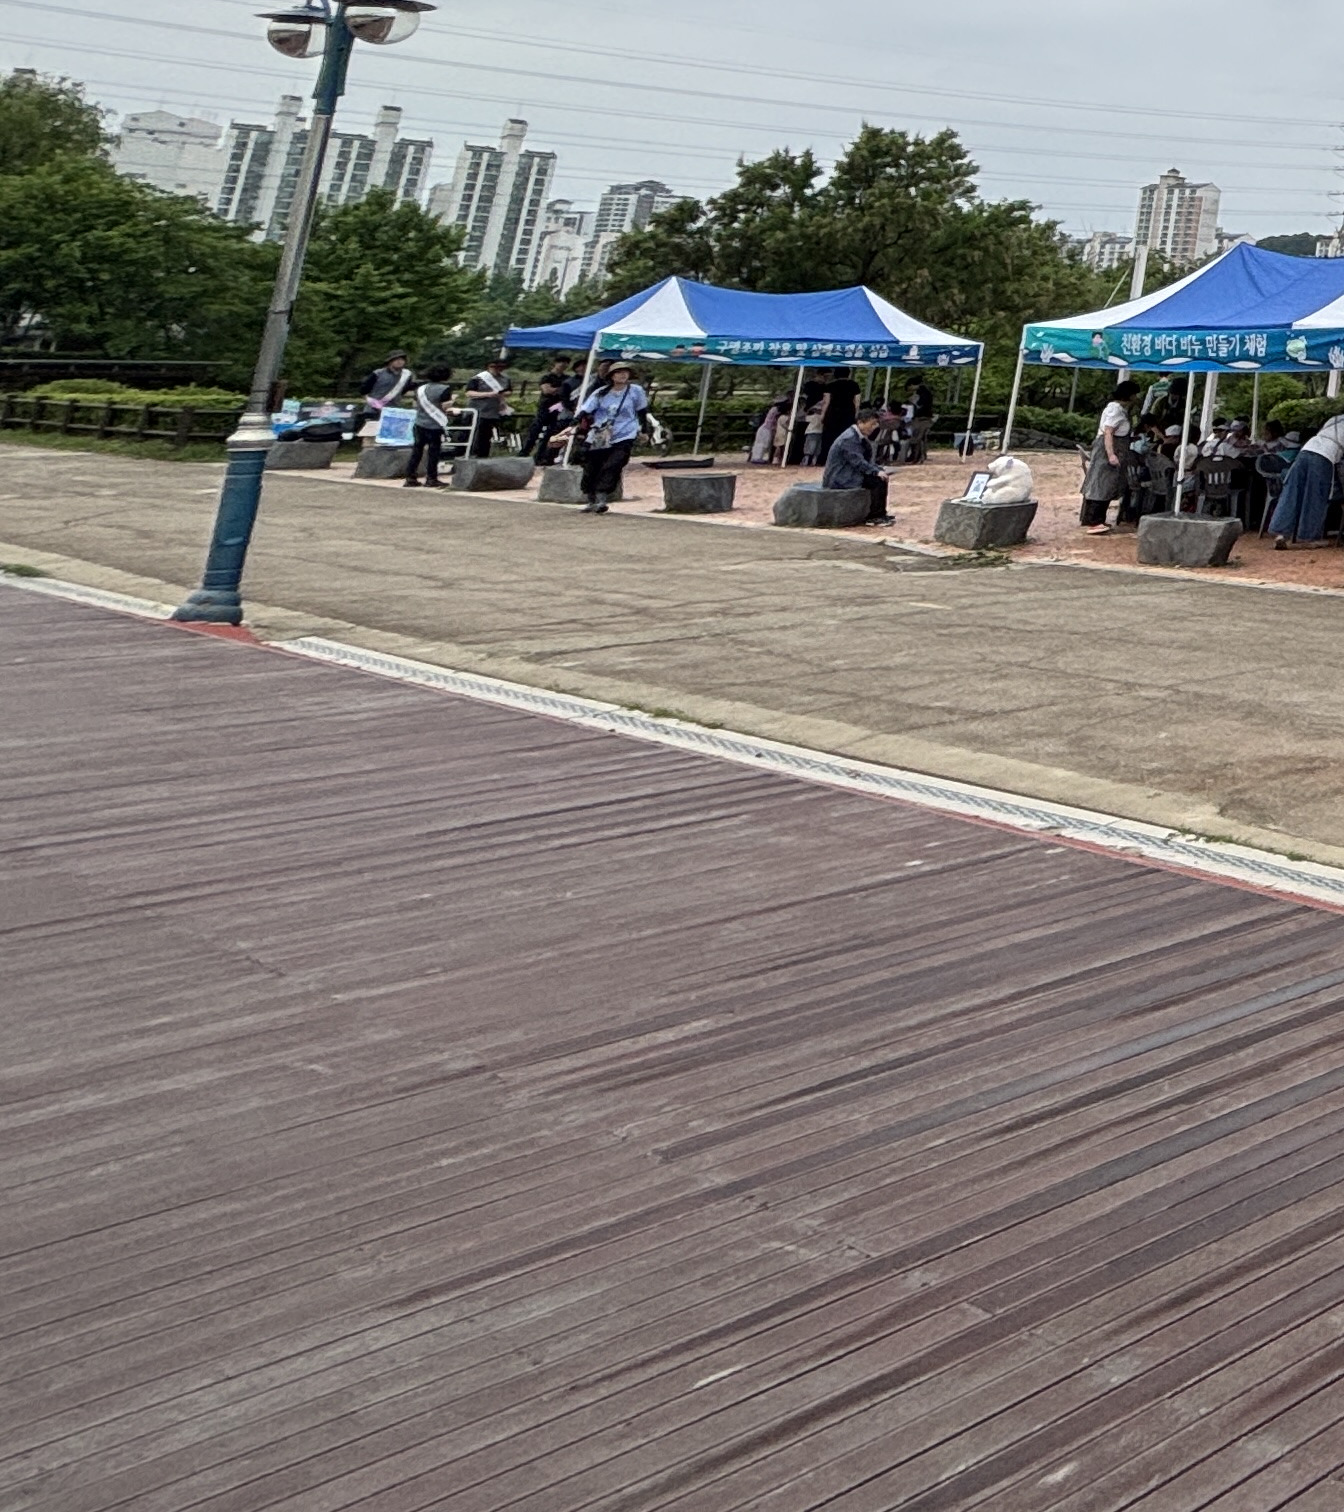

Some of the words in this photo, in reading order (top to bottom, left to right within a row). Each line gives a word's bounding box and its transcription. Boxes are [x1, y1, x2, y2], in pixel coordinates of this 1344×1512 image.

[1120, 333, 1152, 356] 친환경
[1154, 334, 1177, 356] 바다
[1180, 334, 1203, 357] 비누
[1205, 334, 1240, 357] 만들기
[1243, 333, 1268, 357] 체험
